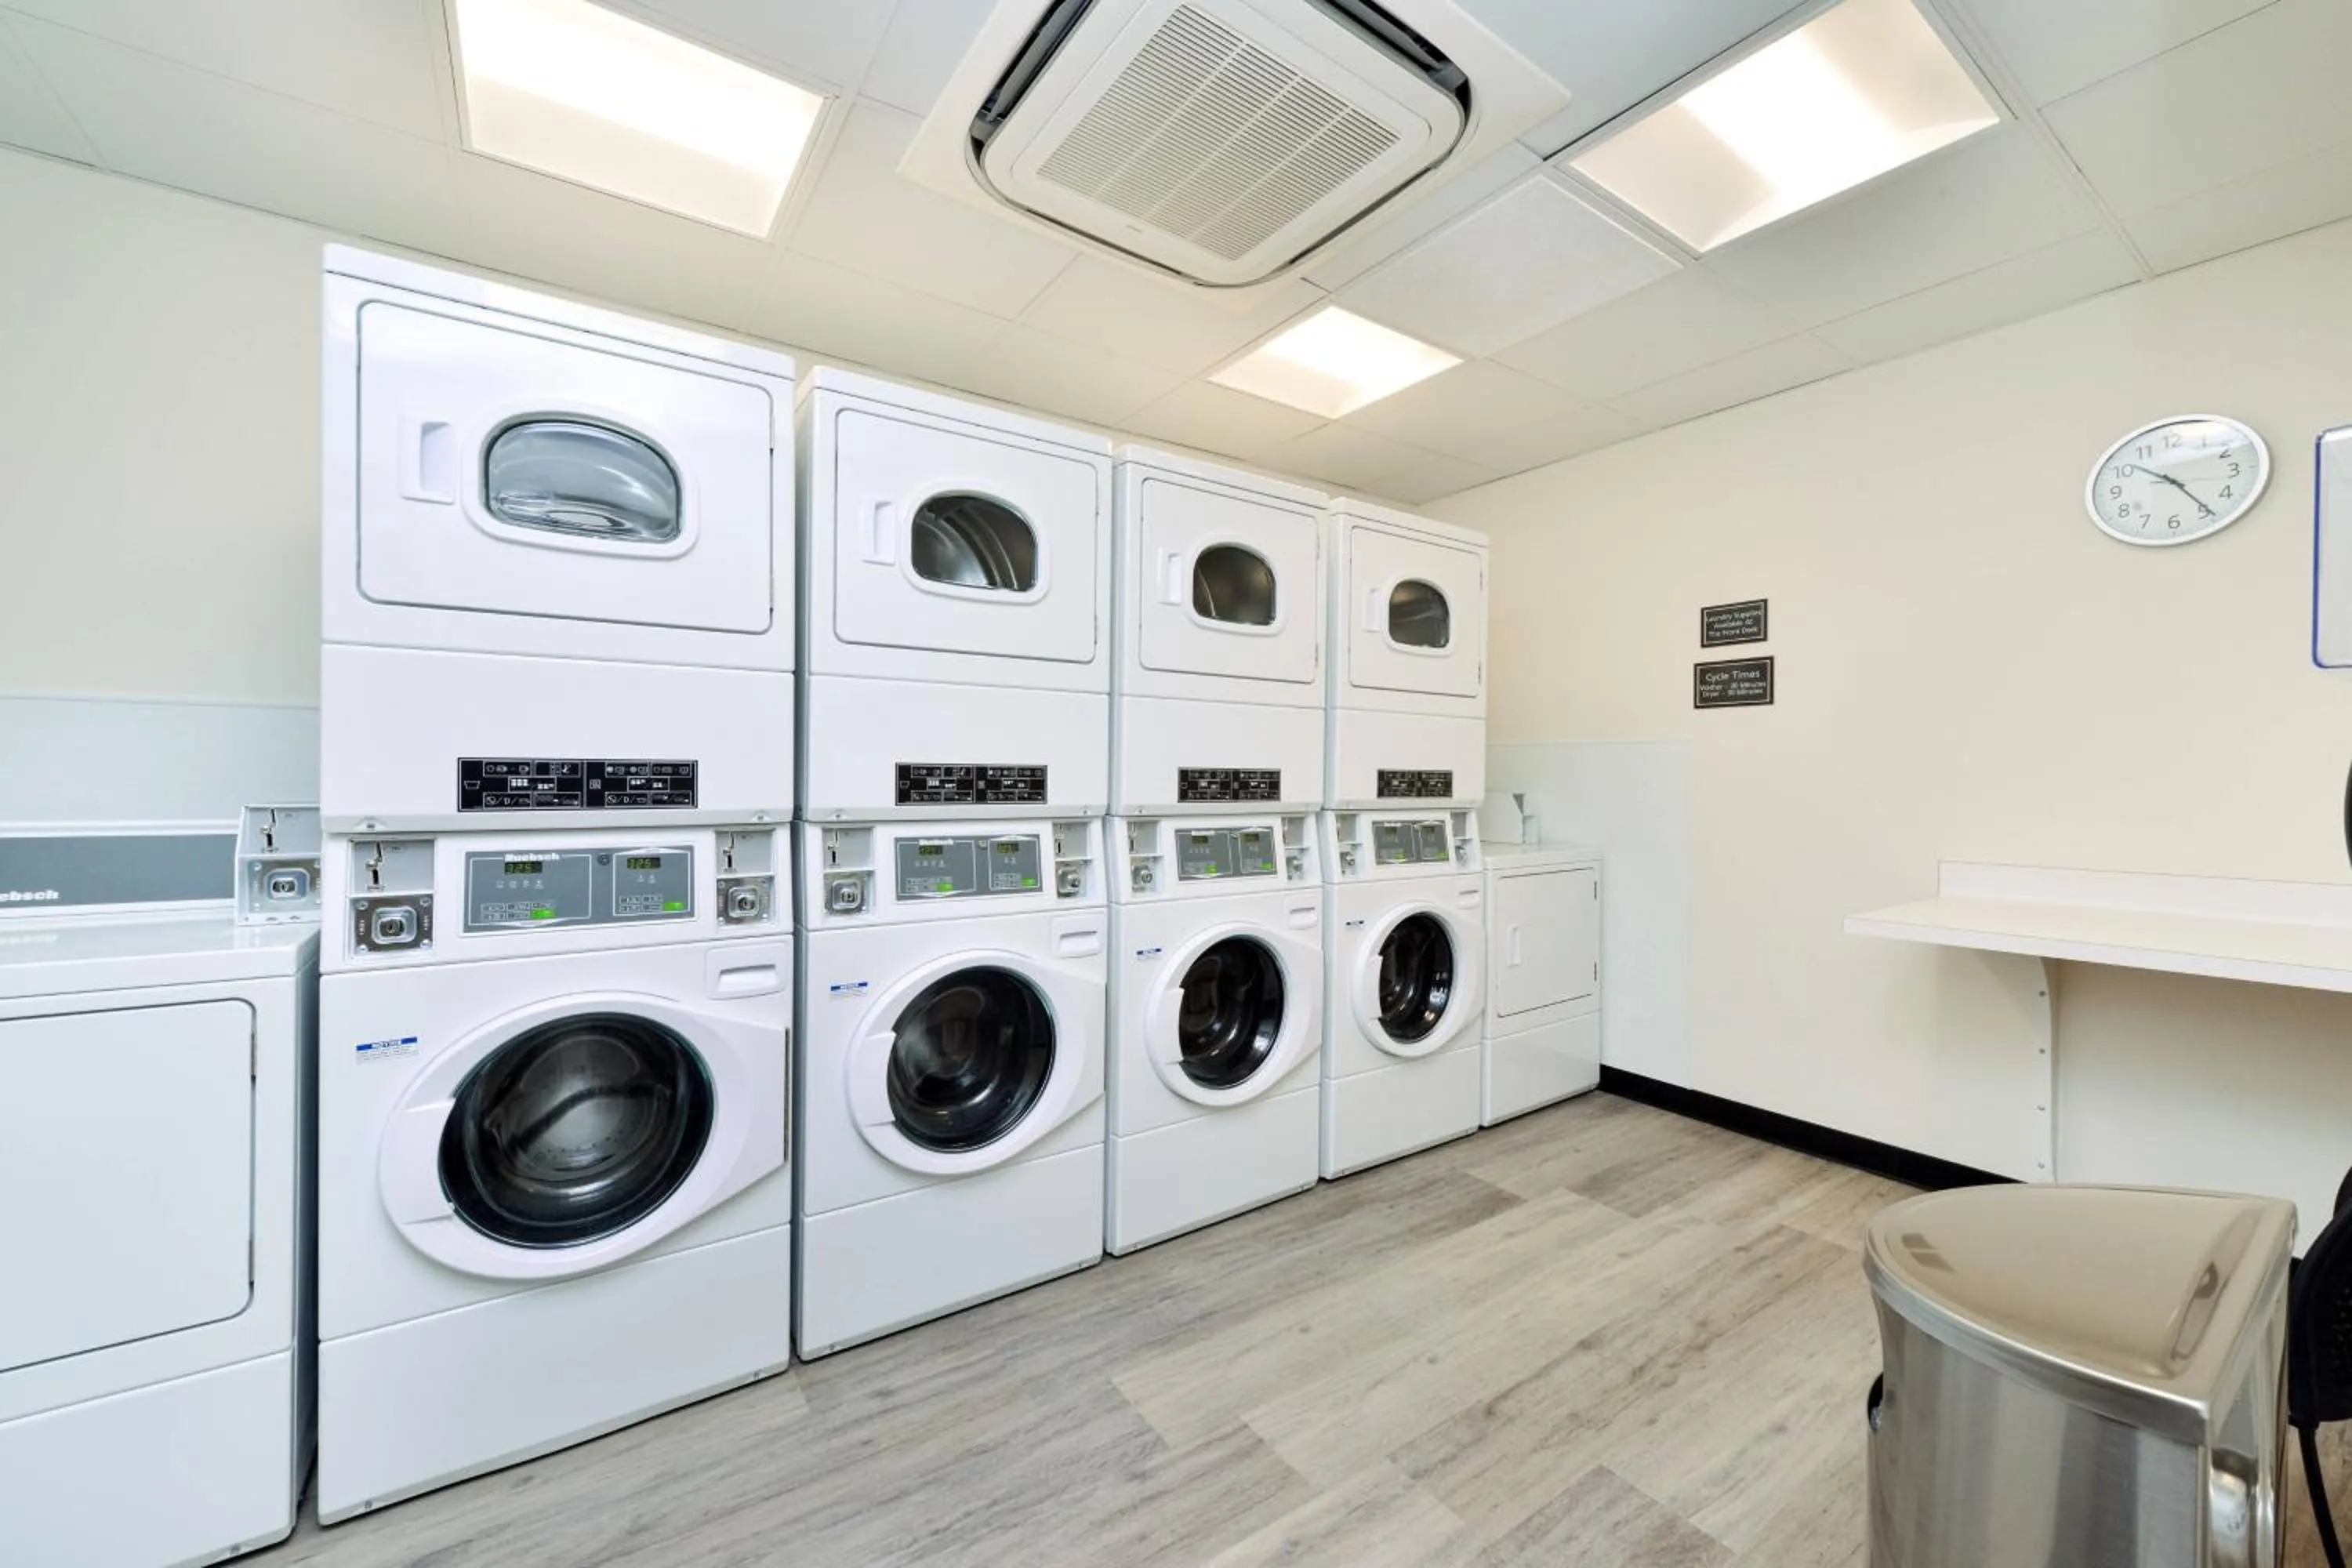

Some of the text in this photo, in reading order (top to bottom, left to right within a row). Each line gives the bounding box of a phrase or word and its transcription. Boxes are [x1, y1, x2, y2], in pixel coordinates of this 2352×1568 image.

[2164, 434, 2183, 448] 12
[2136, 445, 2152, 460] 11
[2220, 444, 2231, 459] 2
[2114, 463, 2134, 478] 10
[2228, 463, 2241, 478] 3
[2110, 485, 2122, 499] 9
[2220, 485, 2233, 499] 4
[2118, 503, 2130, 518] 8
[2198, 504, 2209, 520] 5
[2139, 514, 2151, 529] 7
[2168, 514, 2181, 530] 6
[1705, 670, 1760, 683] Cycle Times
